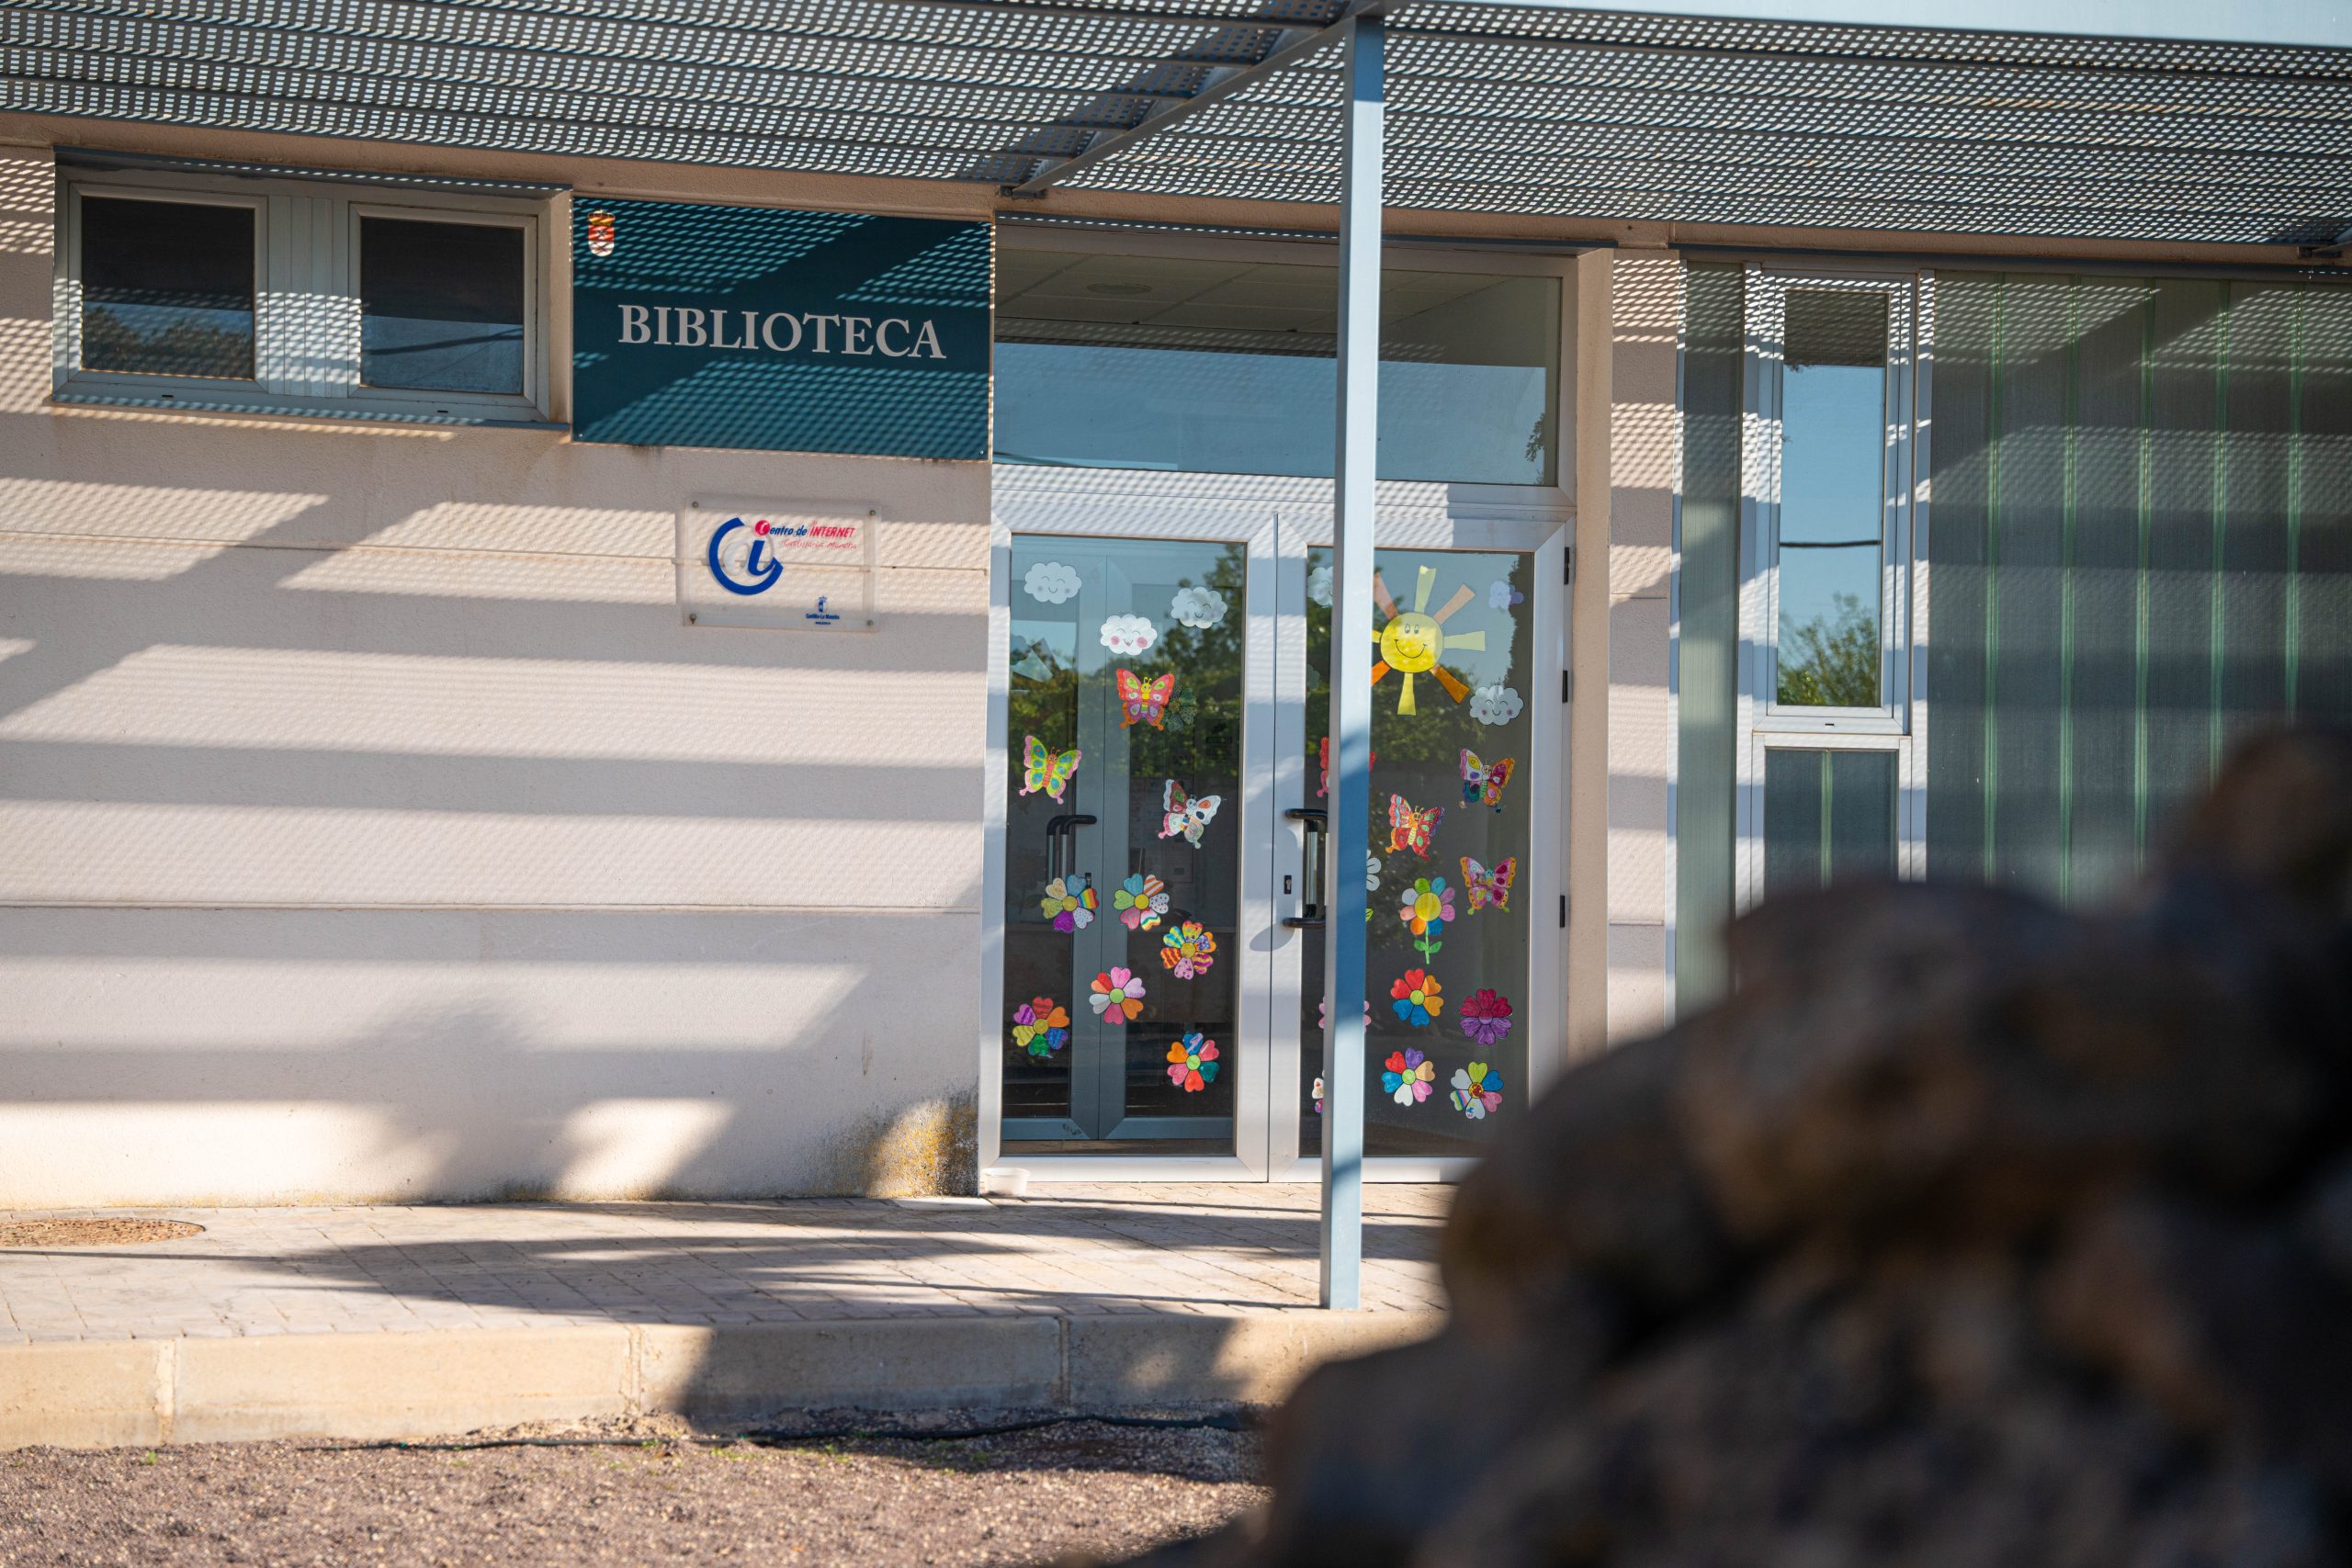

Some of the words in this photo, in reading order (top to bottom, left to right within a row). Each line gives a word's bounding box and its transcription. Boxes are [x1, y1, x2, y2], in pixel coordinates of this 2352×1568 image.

[617, 303, 947, 359] BIBLIOTECA
[755, 520, 794, 536] Centro
[796, 525, 808, 536] de
